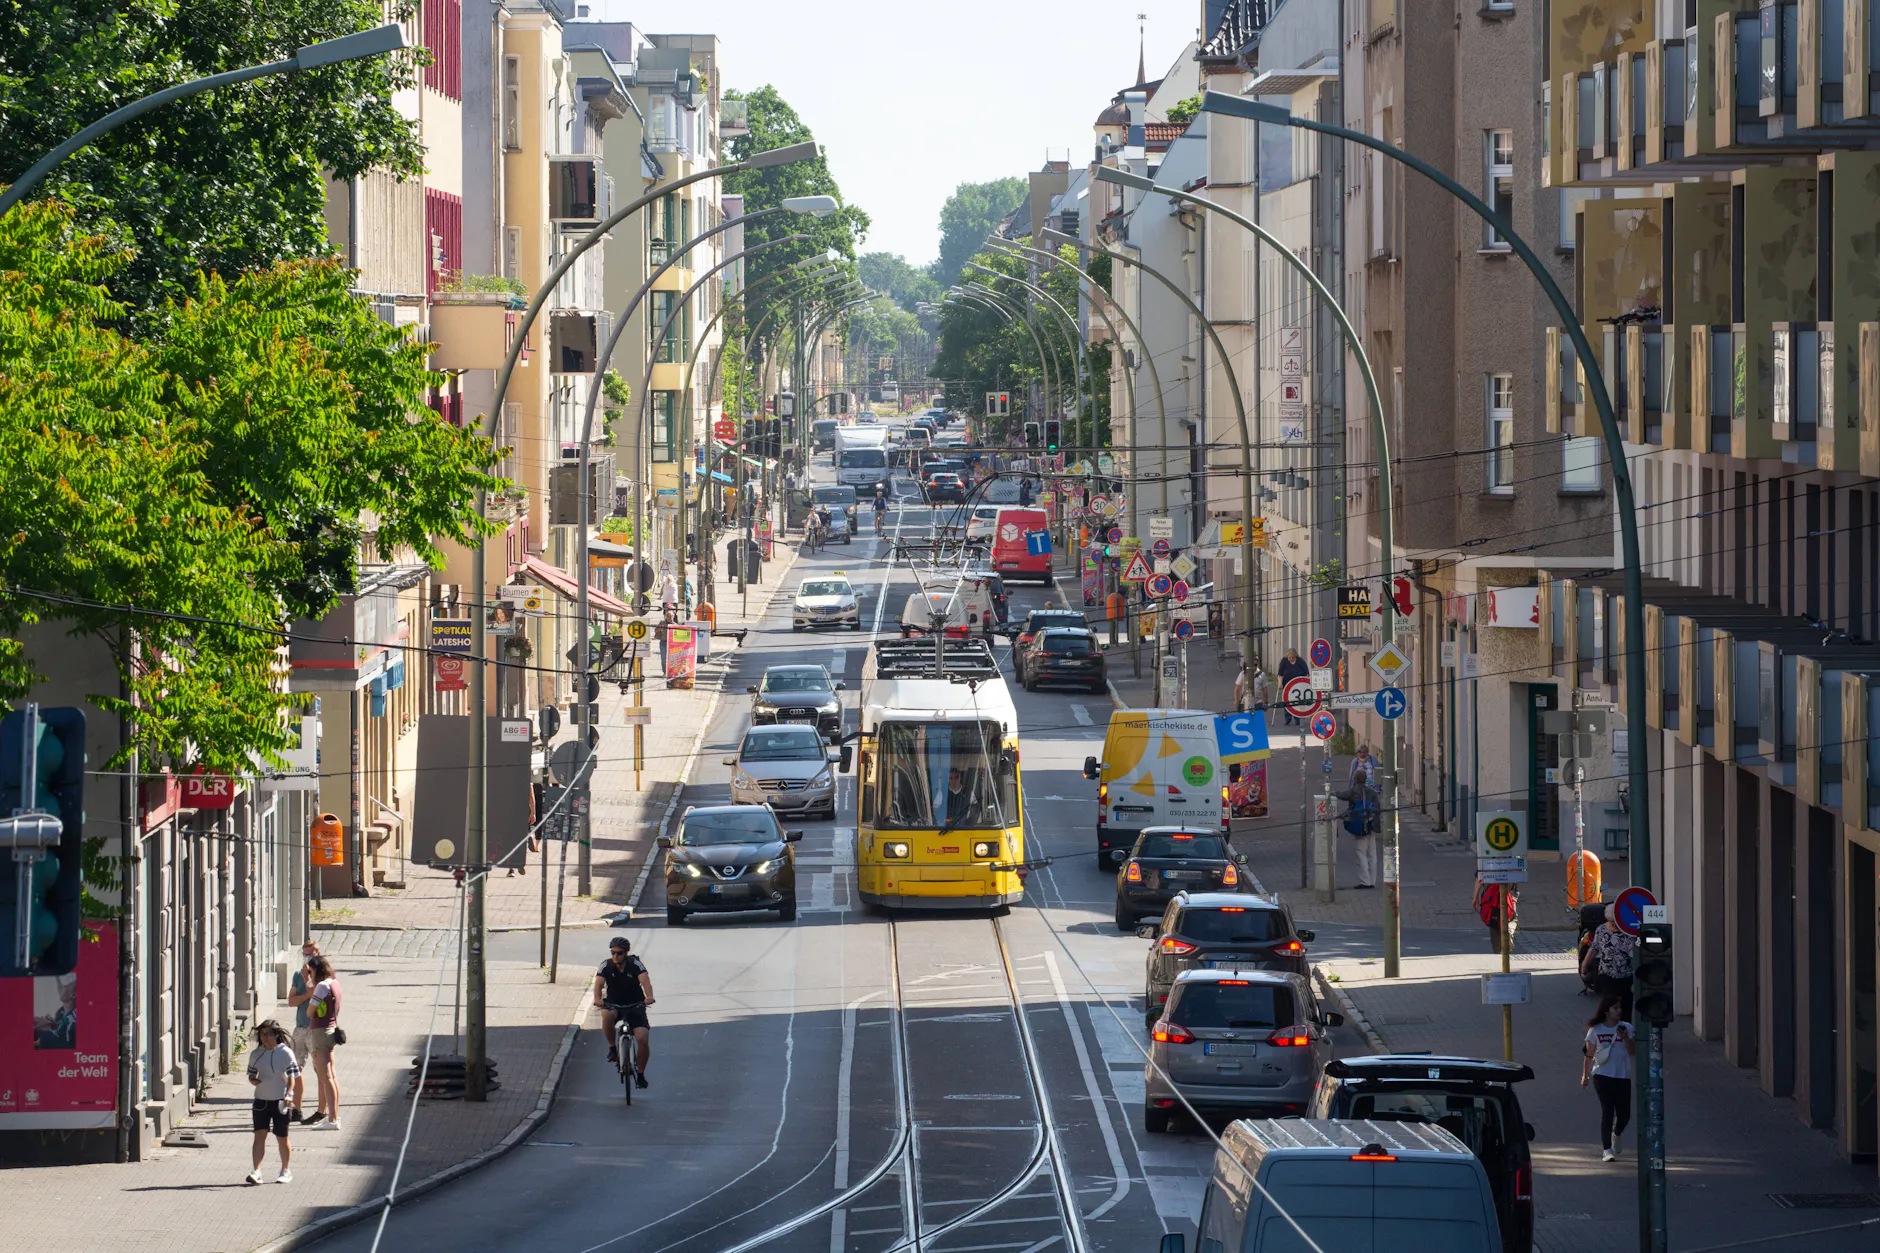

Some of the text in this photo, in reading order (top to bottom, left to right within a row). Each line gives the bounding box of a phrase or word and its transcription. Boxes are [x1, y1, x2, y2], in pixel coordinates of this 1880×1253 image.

[1093, 501, 1107, 511] 30
[1031, 533, 1045, 553] T
[502, 587, 529, 597] Blumen
[1348, 589, 1370, 602] HA
[1291, 688, 1314, 703] 30
[1125, 721, 1208, 731] maerkischekiste.de
[1231, 718, 1254, 749] S
[1494, 825, 1511, 844] H
[1647, 910, 1664, 918] 444
[74, 1051, 108, 1063] Team
[58, 1066, 108, 1078] der Welt
